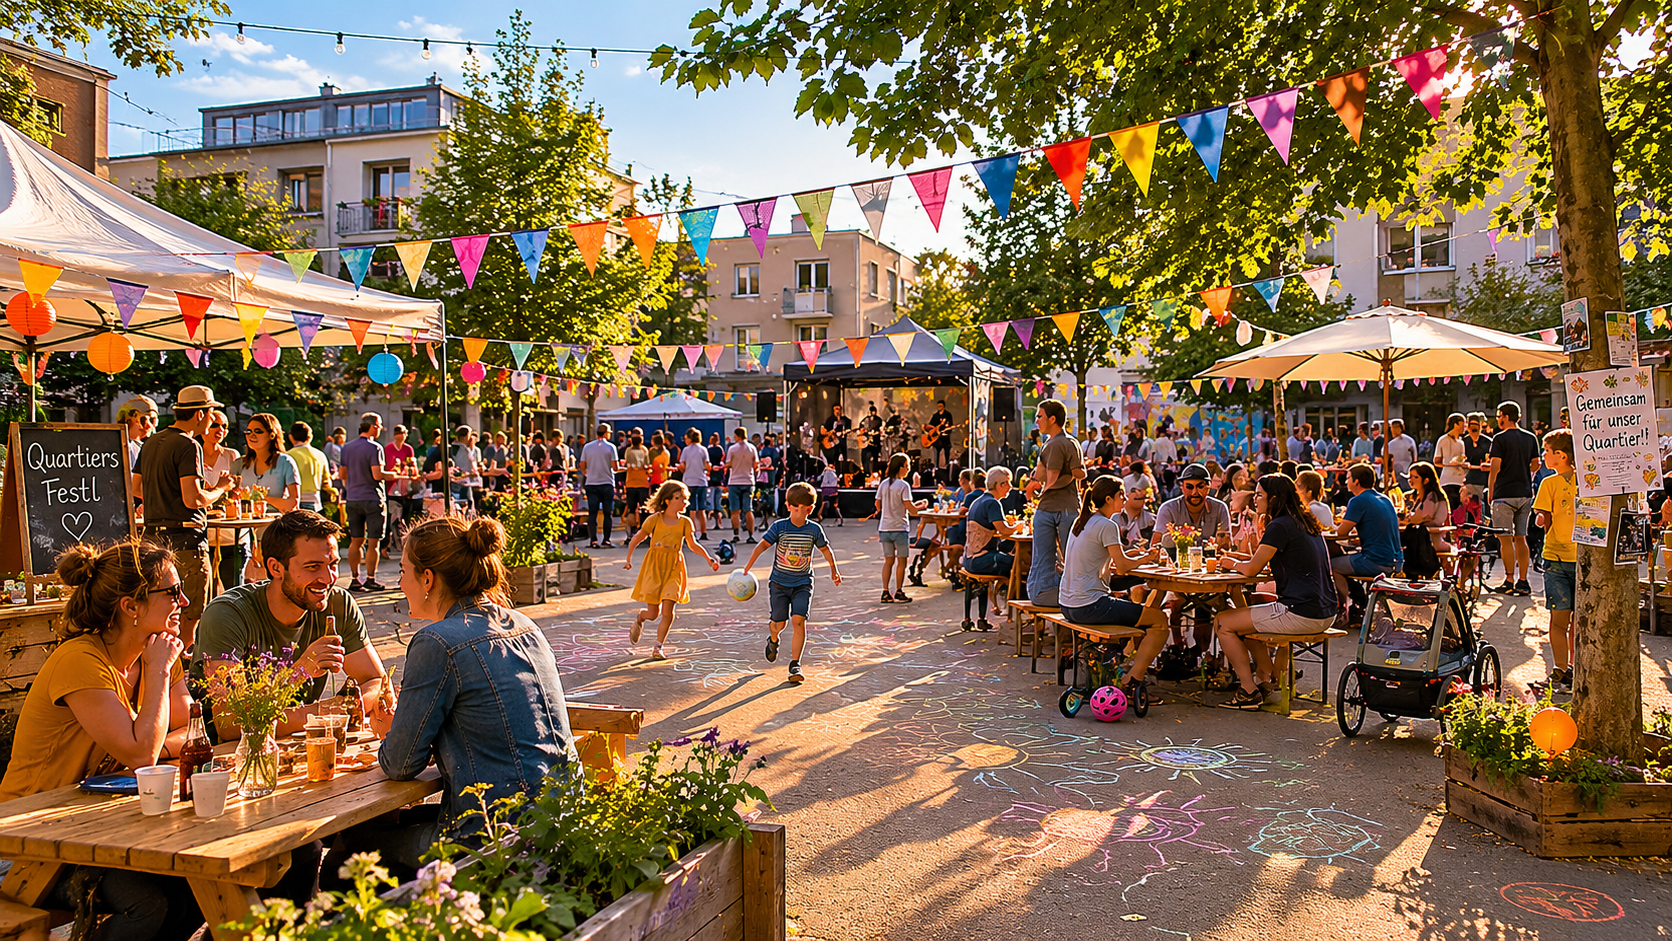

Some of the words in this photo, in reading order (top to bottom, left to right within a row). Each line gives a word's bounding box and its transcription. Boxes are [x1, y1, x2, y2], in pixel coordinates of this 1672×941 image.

[1576, 393, 1646, 412] Gemeinsam
[1608, 414, 1641, 427] unser
[1583, 427, 1649, 453] Quartier!!
[27, 442, 119, 474] Quartiers
[40, 476, 101, 506] Festl
